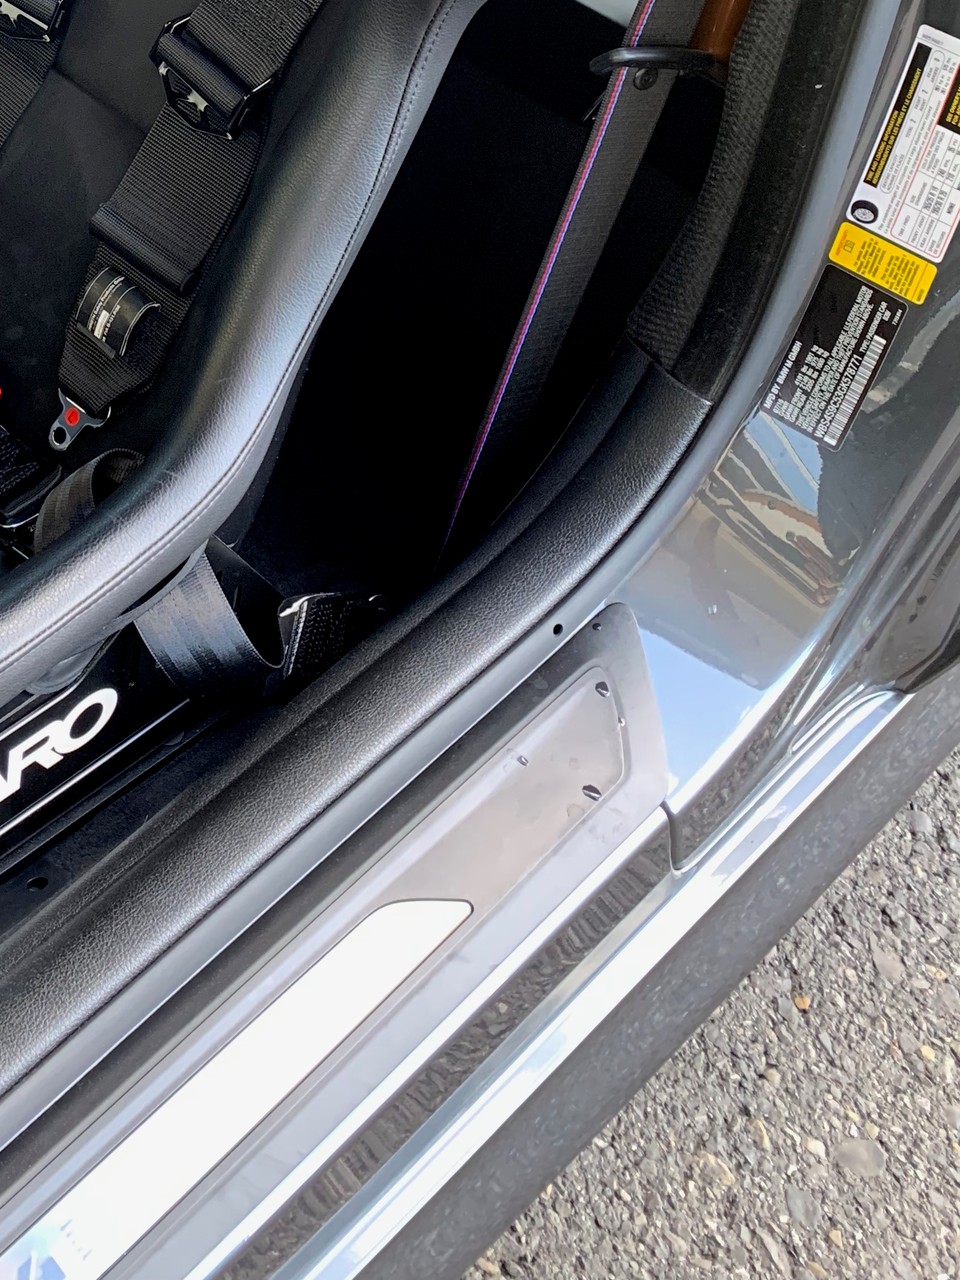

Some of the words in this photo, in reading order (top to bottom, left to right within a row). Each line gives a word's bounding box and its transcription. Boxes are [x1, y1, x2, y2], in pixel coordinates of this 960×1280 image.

[870, 160, 878, 171] AND
[787, 340, 803, 361] GMBH
[775, 365, 790, 384] BMW
[770, 382, 781, 394] BY
[763, 392, 776, 409] MFD
